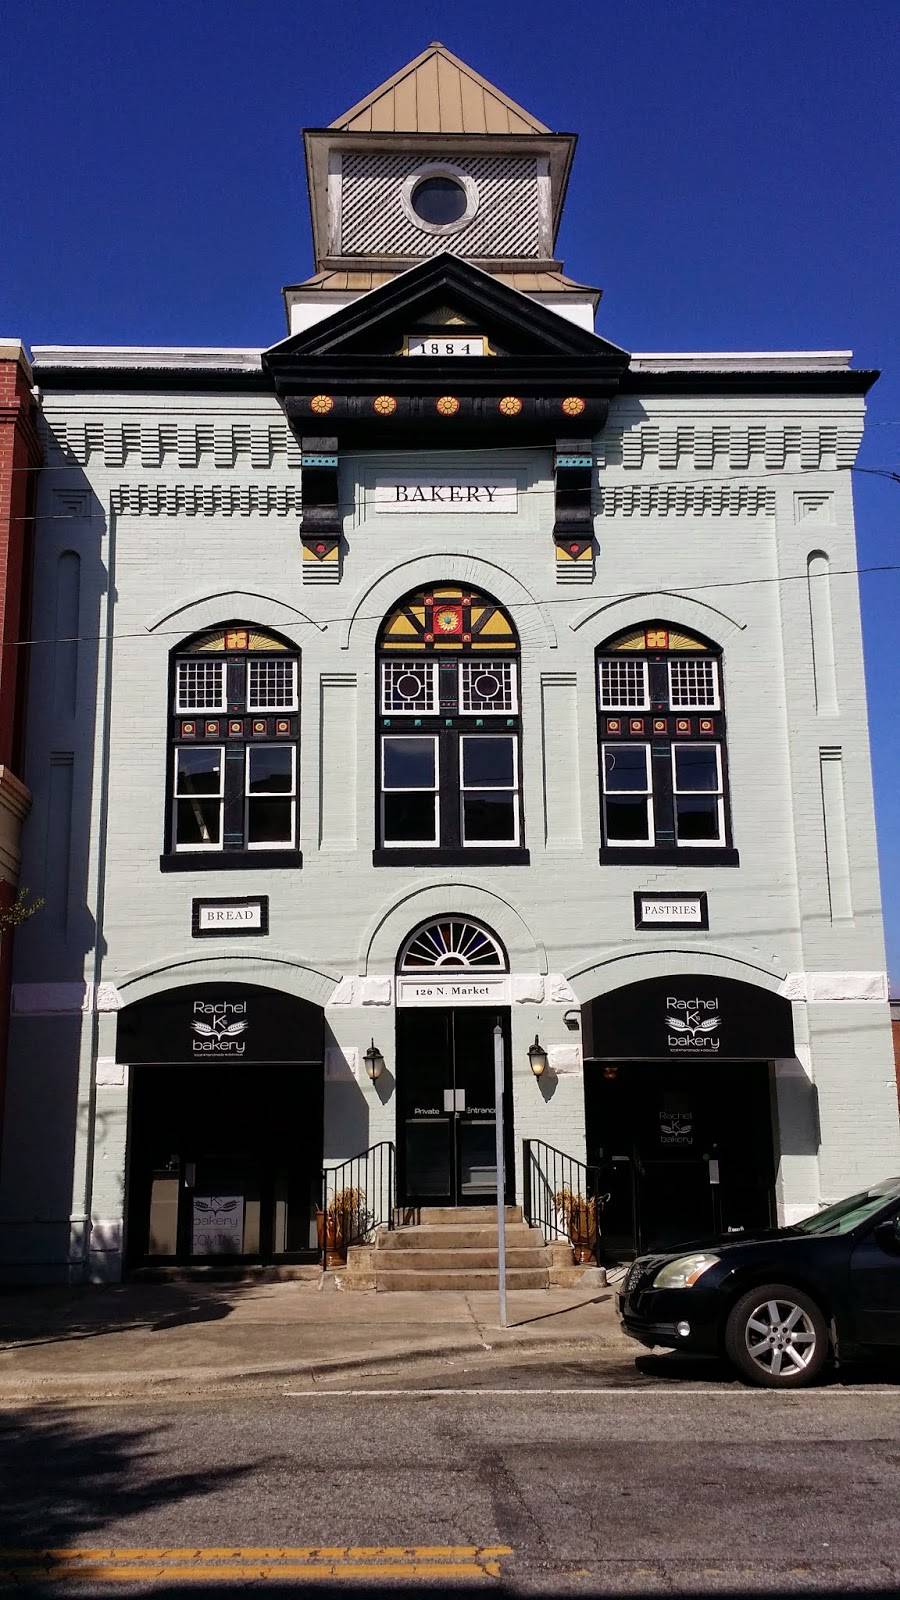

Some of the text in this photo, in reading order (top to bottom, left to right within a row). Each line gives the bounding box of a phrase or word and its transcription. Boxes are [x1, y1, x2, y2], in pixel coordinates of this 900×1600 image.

[420, 343, 471, 355] 1884
[394, 485, 499, 502] BAKERY
[206, 910, 254, 921] BREAD
[644, 905, 697, 915] PASTRIES
[416, 986, 489, 996] 126 N. Market
[193, 1000, 247, 1014] Rachel
[666, 996, 719, 1010] Rachel
[212, 1014, 227, 1030] K
[686, 1010, 700, 1026] K
[192, 1039, 246, 1053] bakery
[667, 1034, 720, 1049] bakery
[414, 1107, 440, 1115] Private
